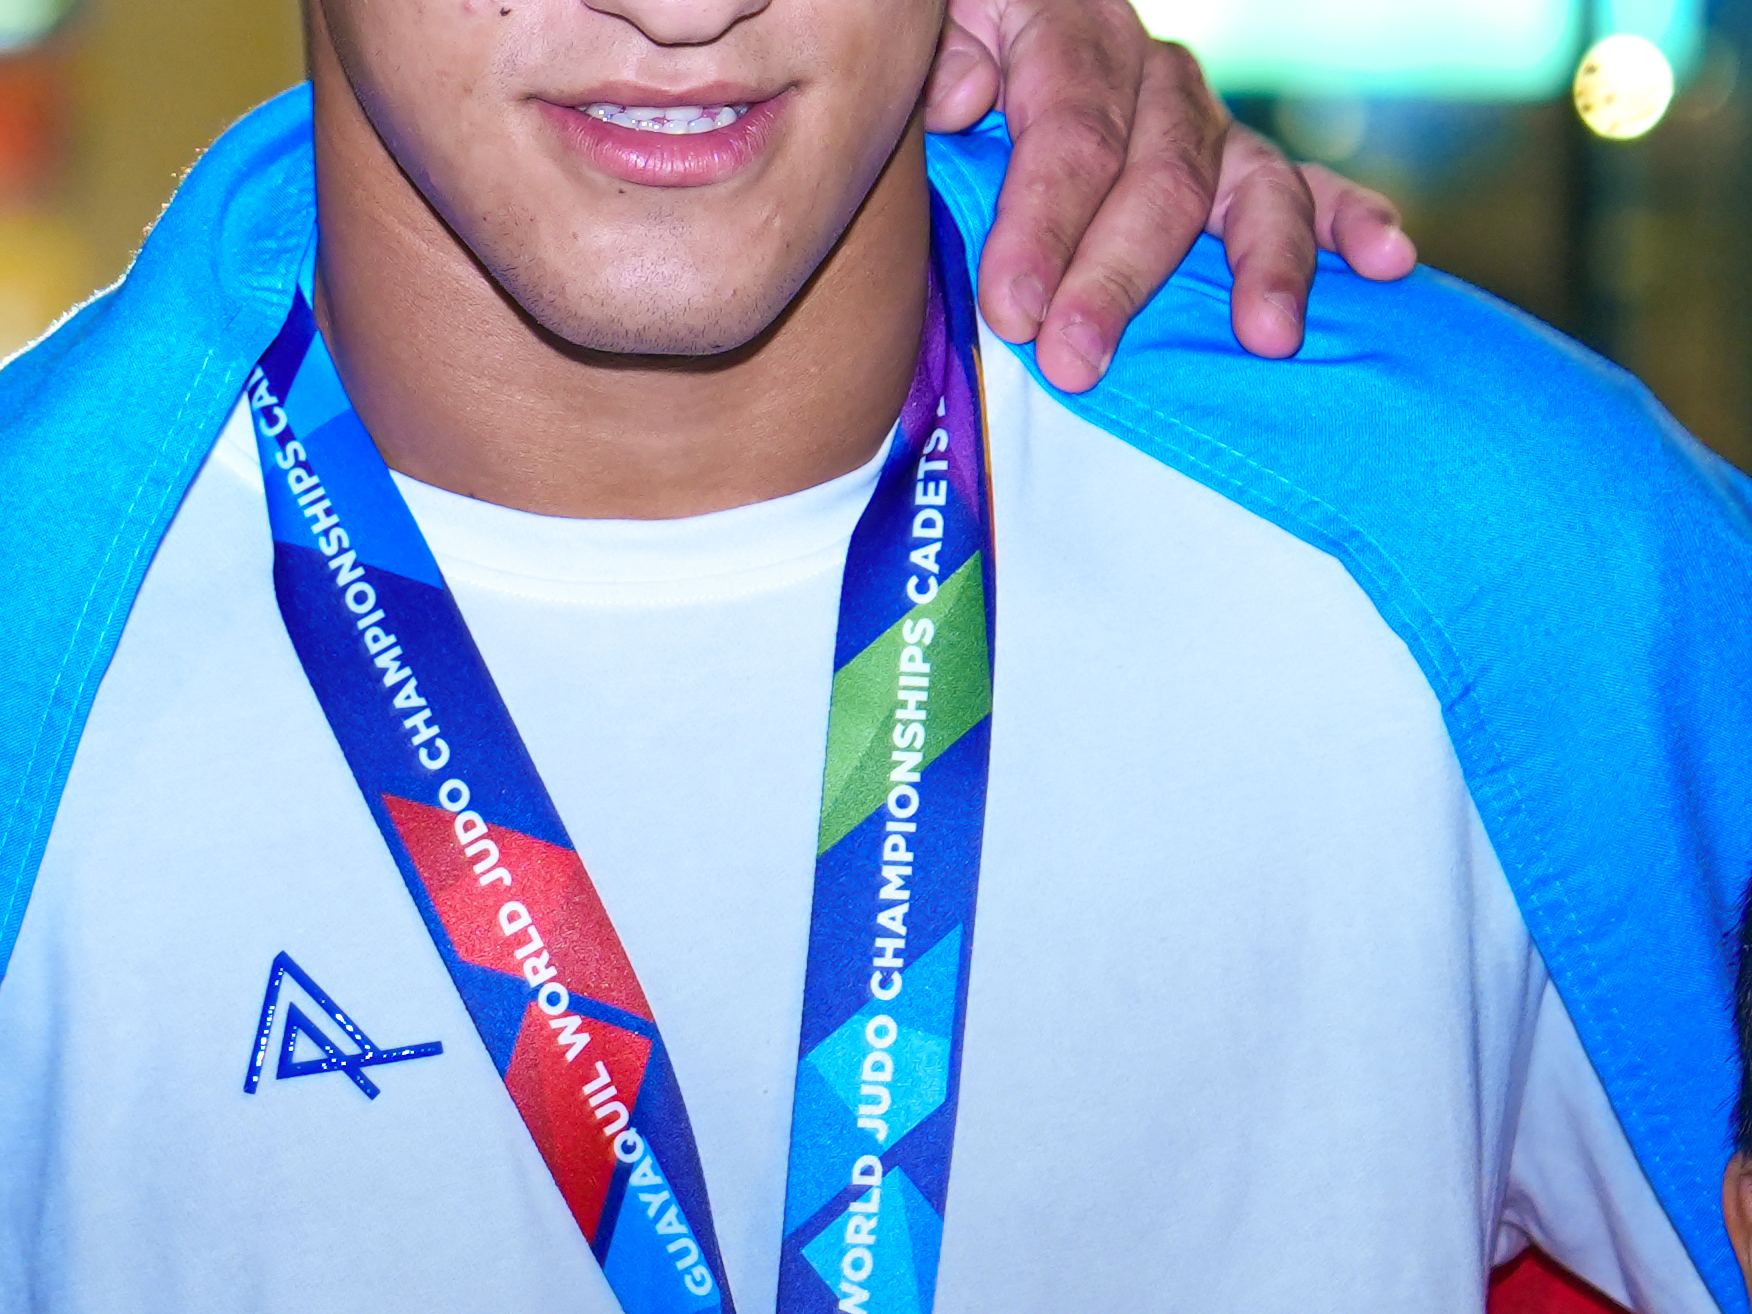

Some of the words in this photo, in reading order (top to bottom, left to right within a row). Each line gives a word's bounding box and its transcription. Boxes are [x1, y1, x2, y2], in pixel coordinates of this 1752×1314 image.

[248, 366, 288, 437] CA
[907, 427, 948, 604] CADETS
[276, 441, 450, 770] CHAMPIONSHIPS
[439, 779, 512, 887] JUDO
[871, 618, 934, 1001] CHAMPIONSHIPS
[499, 901, 591, 1062] WORLD
[857, 1015, 897, 1140] JUDO
[582, 1061, 712, 1296] GUAYAQUIL
